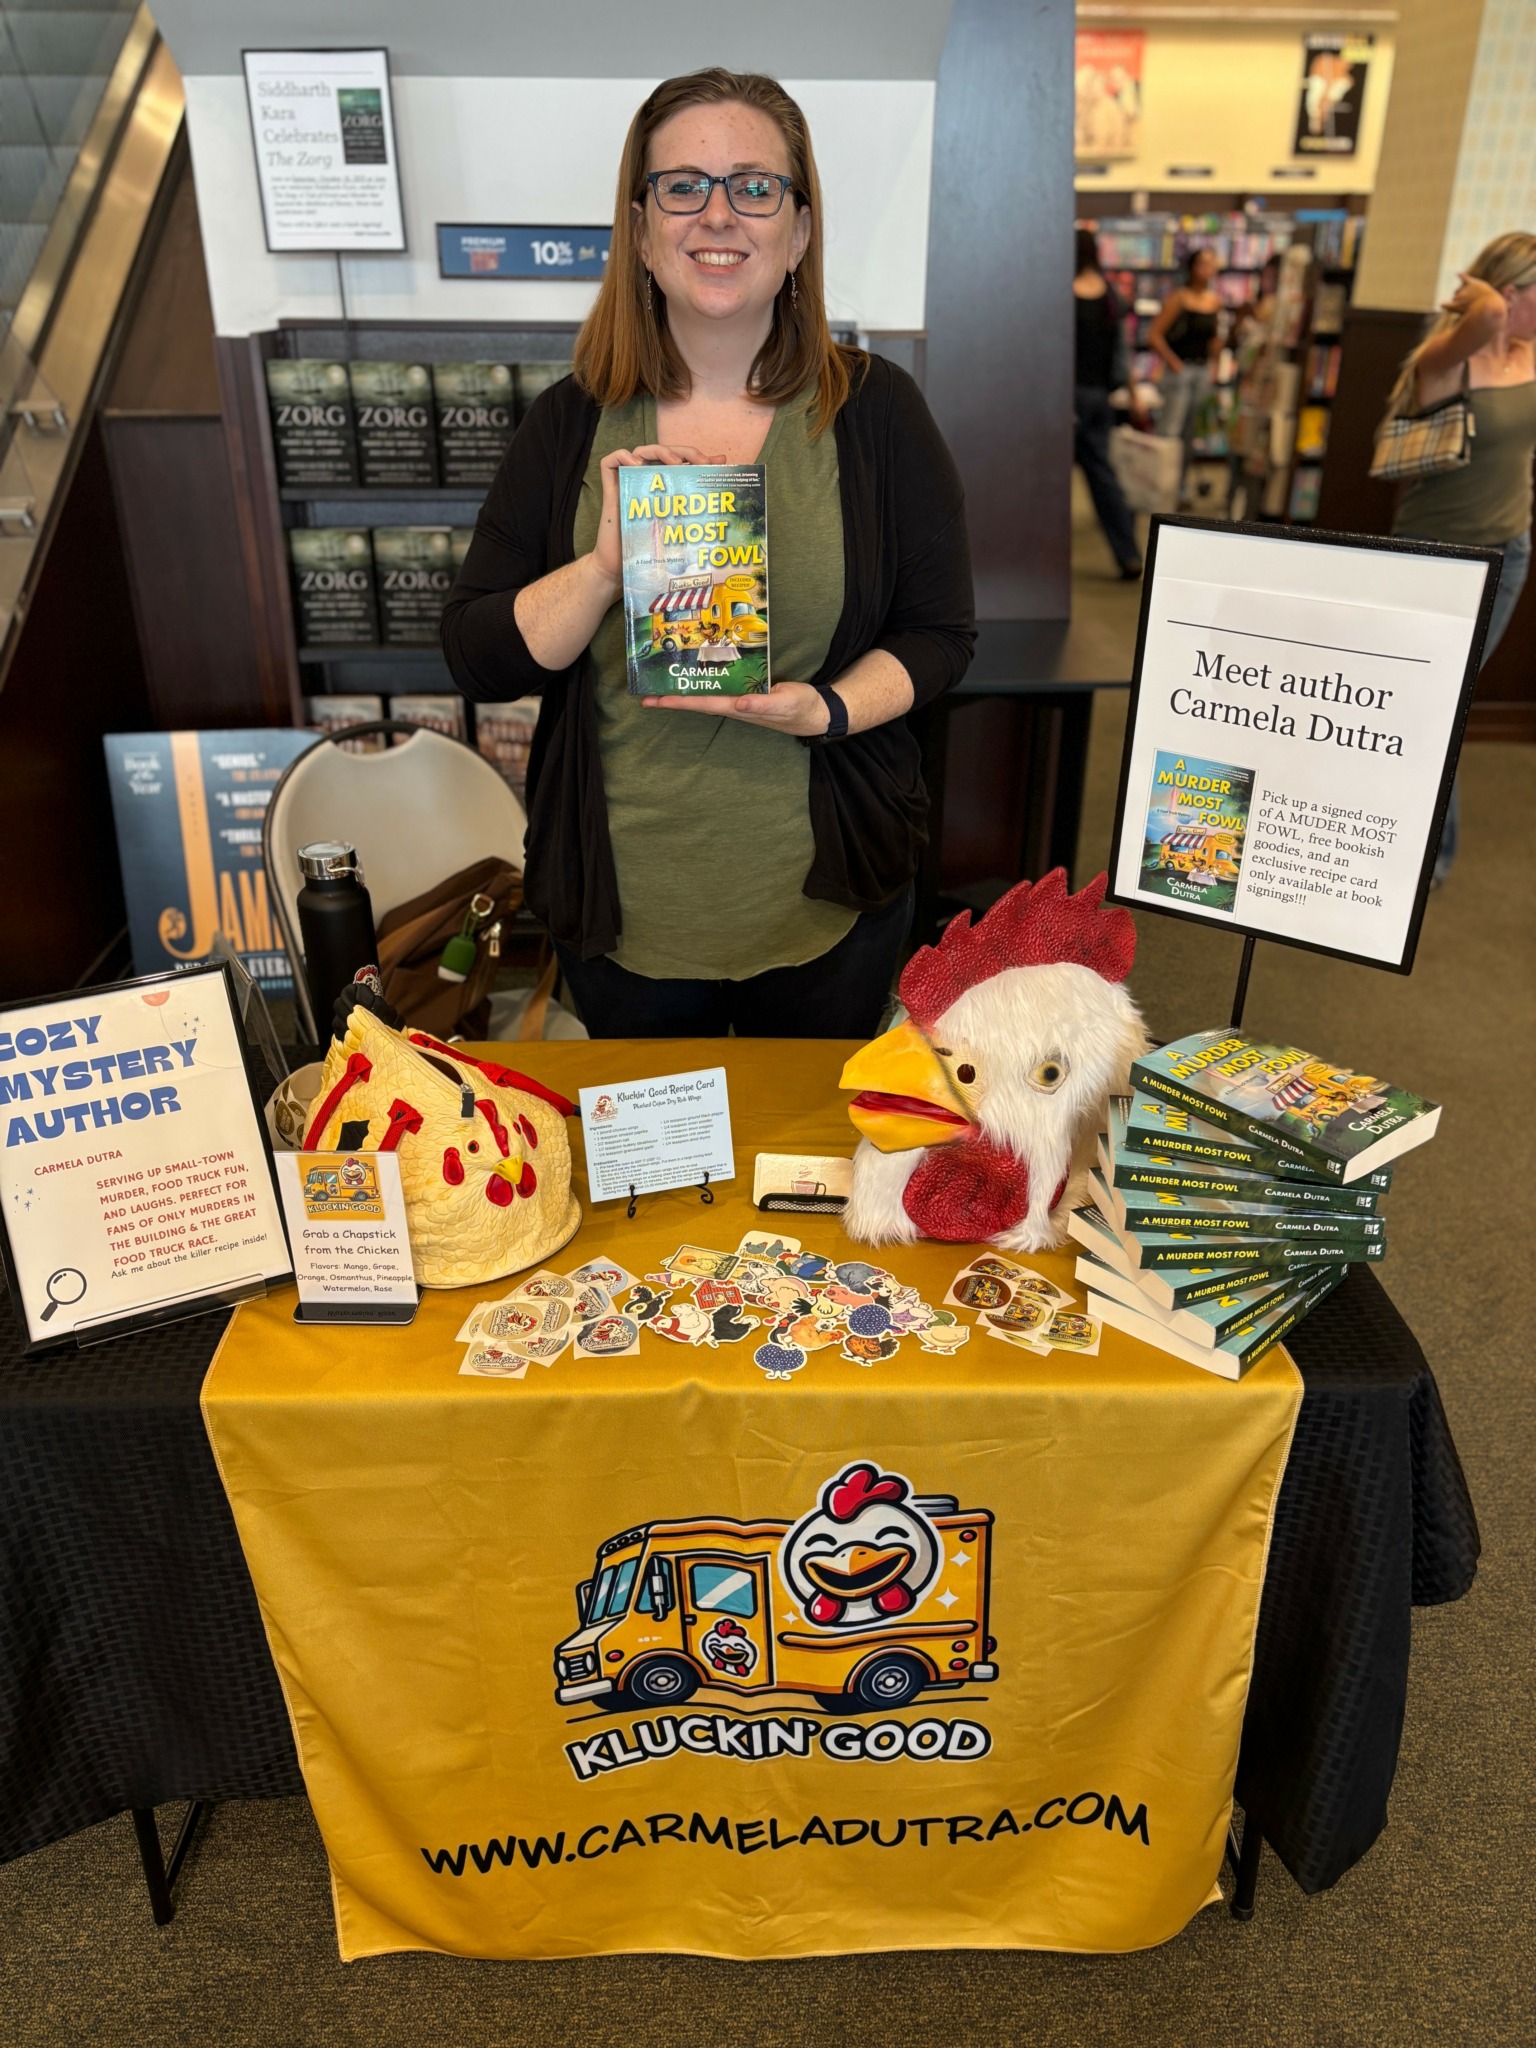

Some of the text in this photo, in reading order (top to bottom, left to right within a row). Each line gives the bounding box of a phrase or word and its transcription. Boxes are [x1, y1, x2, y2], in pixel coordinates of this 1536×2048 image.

[258, 82, 331, 99] Siddharth
[262, 106, 296, 121] Kara
[343, 114, 384, 129] ZORG
[264, 128, 339, 145] Celebrates
[267, 152, 333, 169] The Zorg
[461, 236, 506, 246] PREMIUM
[530, 241, 572, 265] 10%
[277, 406, 347, 427] ZORG
[359, 407, 428, 428] ZORG
[441, 407, 510, 428] ZORG
[650, 474, 666, 492] A
[628, 492, 736, 520] MURDER
[664, 522, 728, 545] MOST
[698, 546, 763, 568] FOWL
[301, 570, 368, 592] ZORG
[383, 570, 450, 592] ZORG
[669, 664, 730, 678] CARMELA
[1192, 650, 1393, 710] Meet author
[678, 676, 722, 690] DUTRA
[1170, 688, 1404, 756] Carmela Dutra
[1175, 759, 1186, 771] A
[1158, 771, 1231, 795] MURDER
[1178, 792, 1224, 811] MOST
[1262, 790, 1398, 829] Pick up a signed copy
[1198, 812, 1244, 831] FOWL
[1259, 808, 1397, 844] of A MUDER MOST
[1257, 821, 1385, 858] FOWL, free bookish
[1254, 840, 1350, 867] goodies, and an
[1252, 854, 1378, 890] exclusive recipe card
[1166, 878, 1208, 894] CARMELA
[1171, 886, 1201, 900] DUTRA
[1247, 883, 1307, 905] signings!!!
[1249, 869, 1383, 907] only available at book
[1166, 1051, 1186, 1062] A
[1169, 1038, 1250, 1080] MURDER
[1216, 1050, 1266, 1077] MOST
[1259, 1050, 1310, 1076] FOWL
[0, 1039, 198, 1105] MYSTERY
[616, 1078, 715, 1103] Kluckin' Good Recipe Card
[1142, 1076, 1228, 1121] A MURDER MOST FOWL
[6, 1086, 182, 1148] AUTHOR
[1348, 1107, 1398, 1132] CARMELA
[1366, 1116, 1407, 1135] DUTRA
[1153, 1139, 1193, 1152] MURDER
[1194, 1146, 1222, 1157] MOST
[1224, 1151, 1252, 1162] FOWL
[1249, 1125, 1304, 1157] CARMELA DUTRA
[34, 1150, 123, 1177] CARMELA DUTRA
[96, 1151, 235, 1190] SERVING UP SMALL-TOWN
[100, 1164, 250, 1205] MURDER, FOOD TRUCK FUN,
[1140, 1175, 1180, 1186] MURDER
[1182, 1180, 1209, 1189] MOST
[1211, 1183, 1239, 1192] FOWL
[103, 1179, 248, 1221] AND LAUGHS. PERFECT FOR
[1265, 1189, 1330, 1202] CARMELA DUTRA
[106, 1193, 256, 1236] FANS OF ONLY MURDERS IN
[307, 1203, 382, 1214] KLUCKIN' GOOD
[110, 1208, 258, 1252] THE BUILDING & THE GREAT
[303, 1230, 329, 1239] Grab
[342, 1230, 397, 1241] Chapstick
[111, 1233, 268, 1279] Ask me about the killer recipe inside!
[114, 1234, 219, 1267] FOOD TRUCK RACE.
[304, 1245, 400, 1255] from the Chicken
[297, 1274, 415, 1282] Orange, Osmanthus, Pineapple,
[343, 1263, 371, 1272] Mango,
[373, 1264, 399, 1272] Grape,
[323, 1285, 373, 1293] Watermelon,
[566, 1716, 991, 1780] KLUCKIN' GOOD
[421, 1792, 1151, 1877] WWW.CARMELADUTRA.COM
